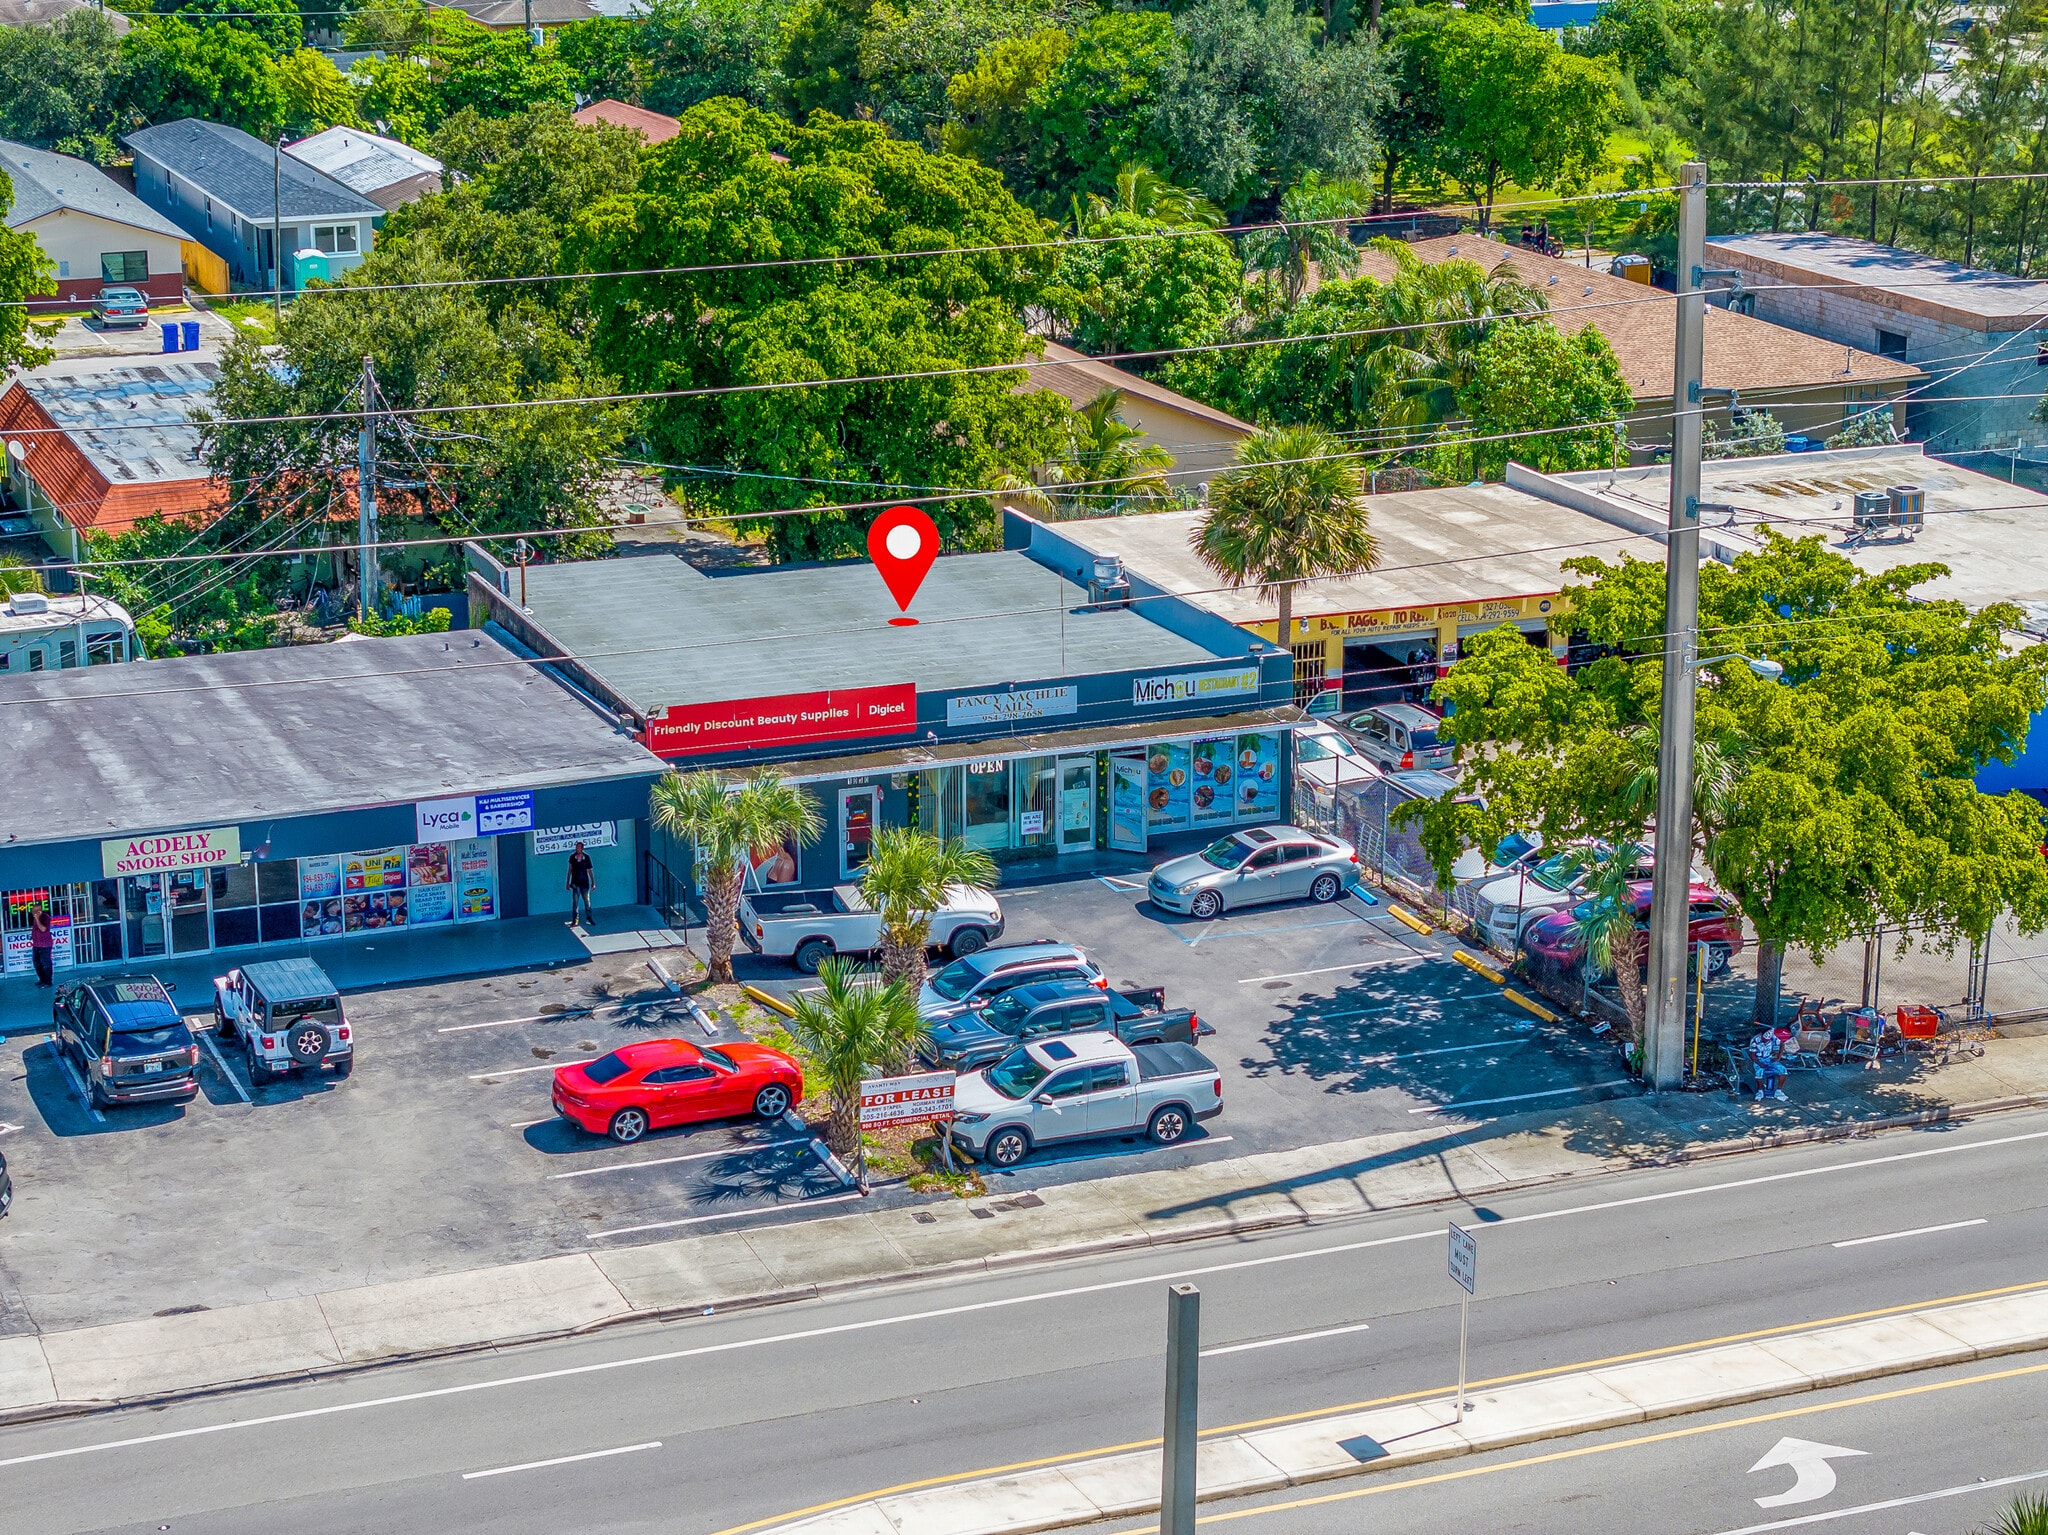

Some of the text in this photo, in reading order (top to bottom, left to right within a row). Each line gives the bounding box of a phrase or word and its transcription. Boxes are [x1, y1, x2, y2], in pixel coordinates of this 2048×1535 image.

[1136, 671, 1257, 702] Michou RESTAURANT #2
[957, 687, 1068, 708] FANCY NACHLIE
[994, 701, 1033, 713] NAILS
[654, 702, 905, 736] Friendly Discount Beauty Supplies Digicel
[970, 760, 1003, 774] OPEN
[490, 794, 530, 803] MULTISERVICES
[490, 801, 525, 809] BARBERSHOP
[423, 811, 459, 828] Lyca
[439, 823, 460, 831] Mobile
[126, 833, 211, 857] ACDELY
[536, 842, 560, 853] (954)
[117, 849, 227, 872] SMOKE SHOP
[365, 859, 381, 867] UNI
[384, 858, 401, 869] Ria
[865, 1086, 951, 1106] FOR LEASE
[892, 1116, 930, 1125] COMMERCIAL
[931, 1112, 951, 1120] RETAIL
[1451, 1230, 1474, 1254] LEFT LANE
[1454, 1248, 1469, 1268] MUST
[1450, 1261, 1472, 1286] TURN LEFT
